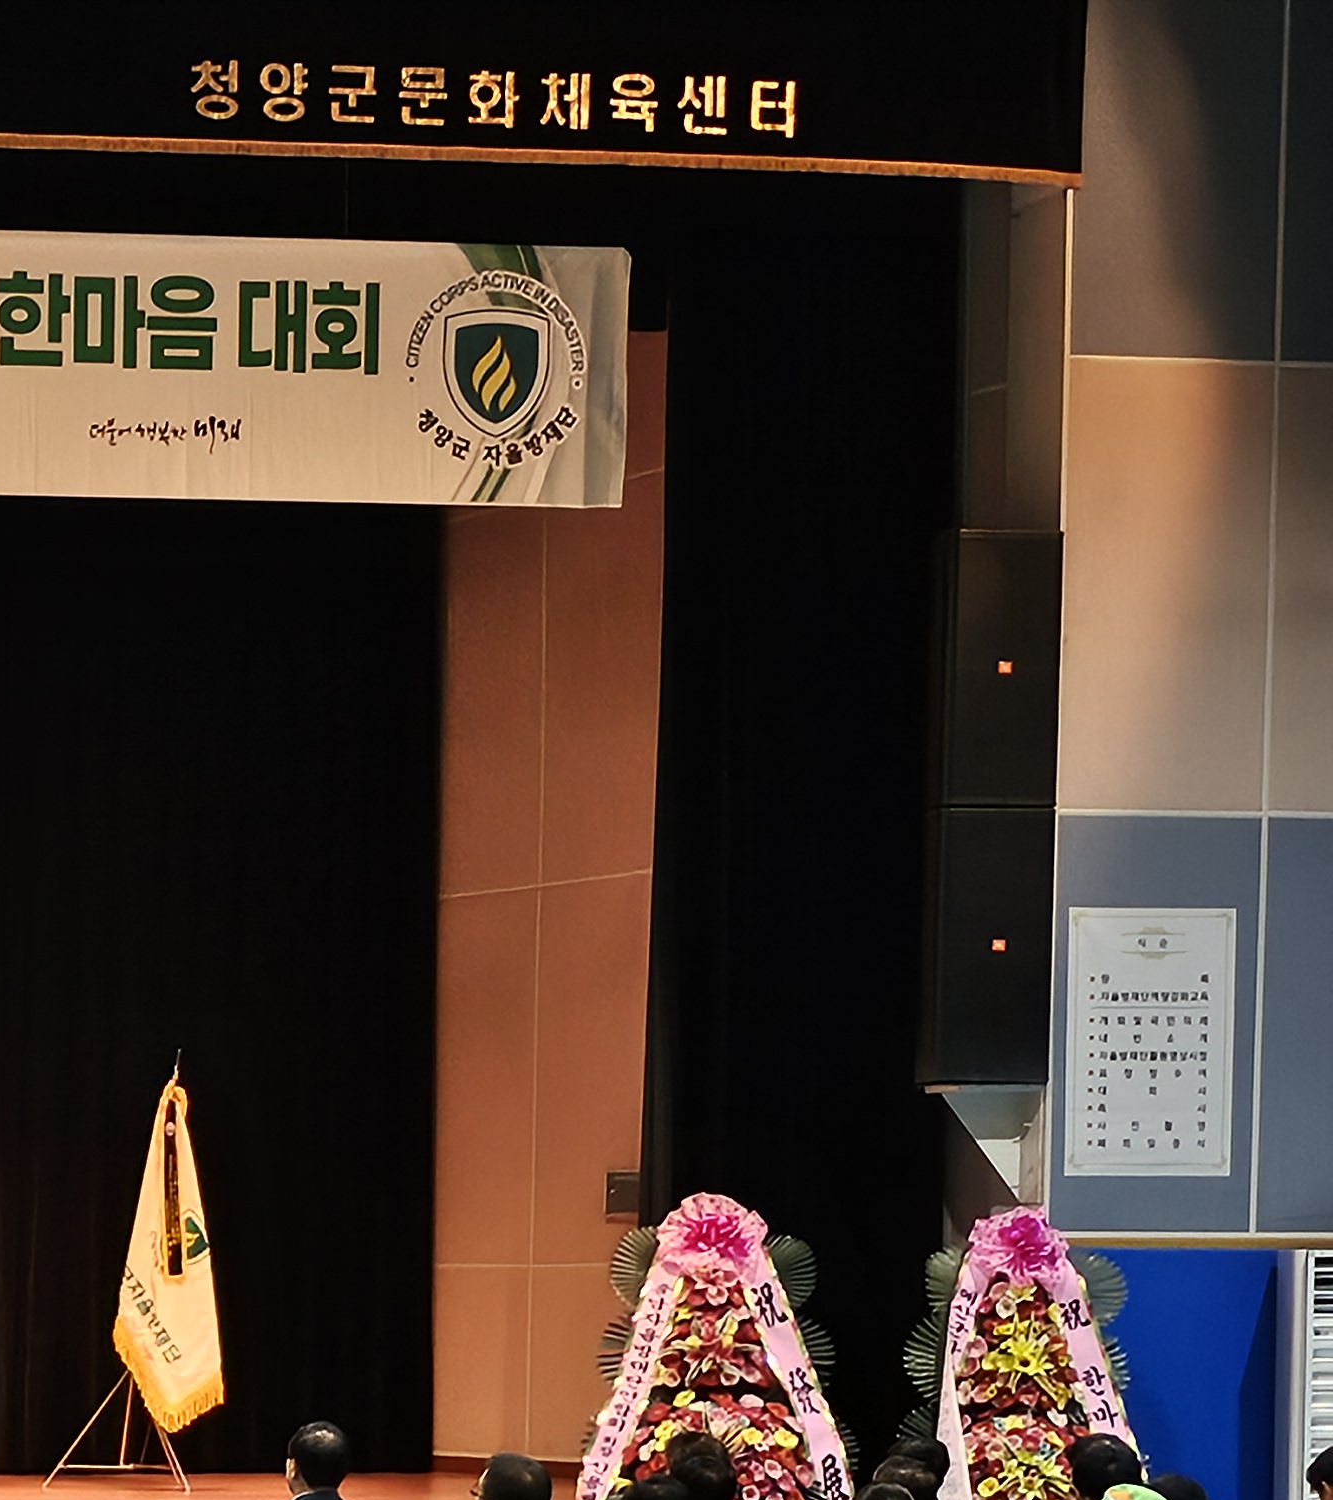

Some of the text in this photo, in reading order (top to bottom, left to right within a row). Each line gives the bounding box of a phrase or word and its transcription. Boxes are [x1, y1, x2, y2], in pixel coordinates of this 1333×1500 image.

[190, 59, 799, 139] 청양군문화체육센터
[237, 277, 382, 378] 대회
[405, 308, 436, 369] CITIZEN
[429, 275, 480, 315] CORPS
[479, 271, 534, 297] ACTIVE
[417, 405, 579, 467] 청양군 자율방재단
[1083, 1365, 1120, 1429] 한마
